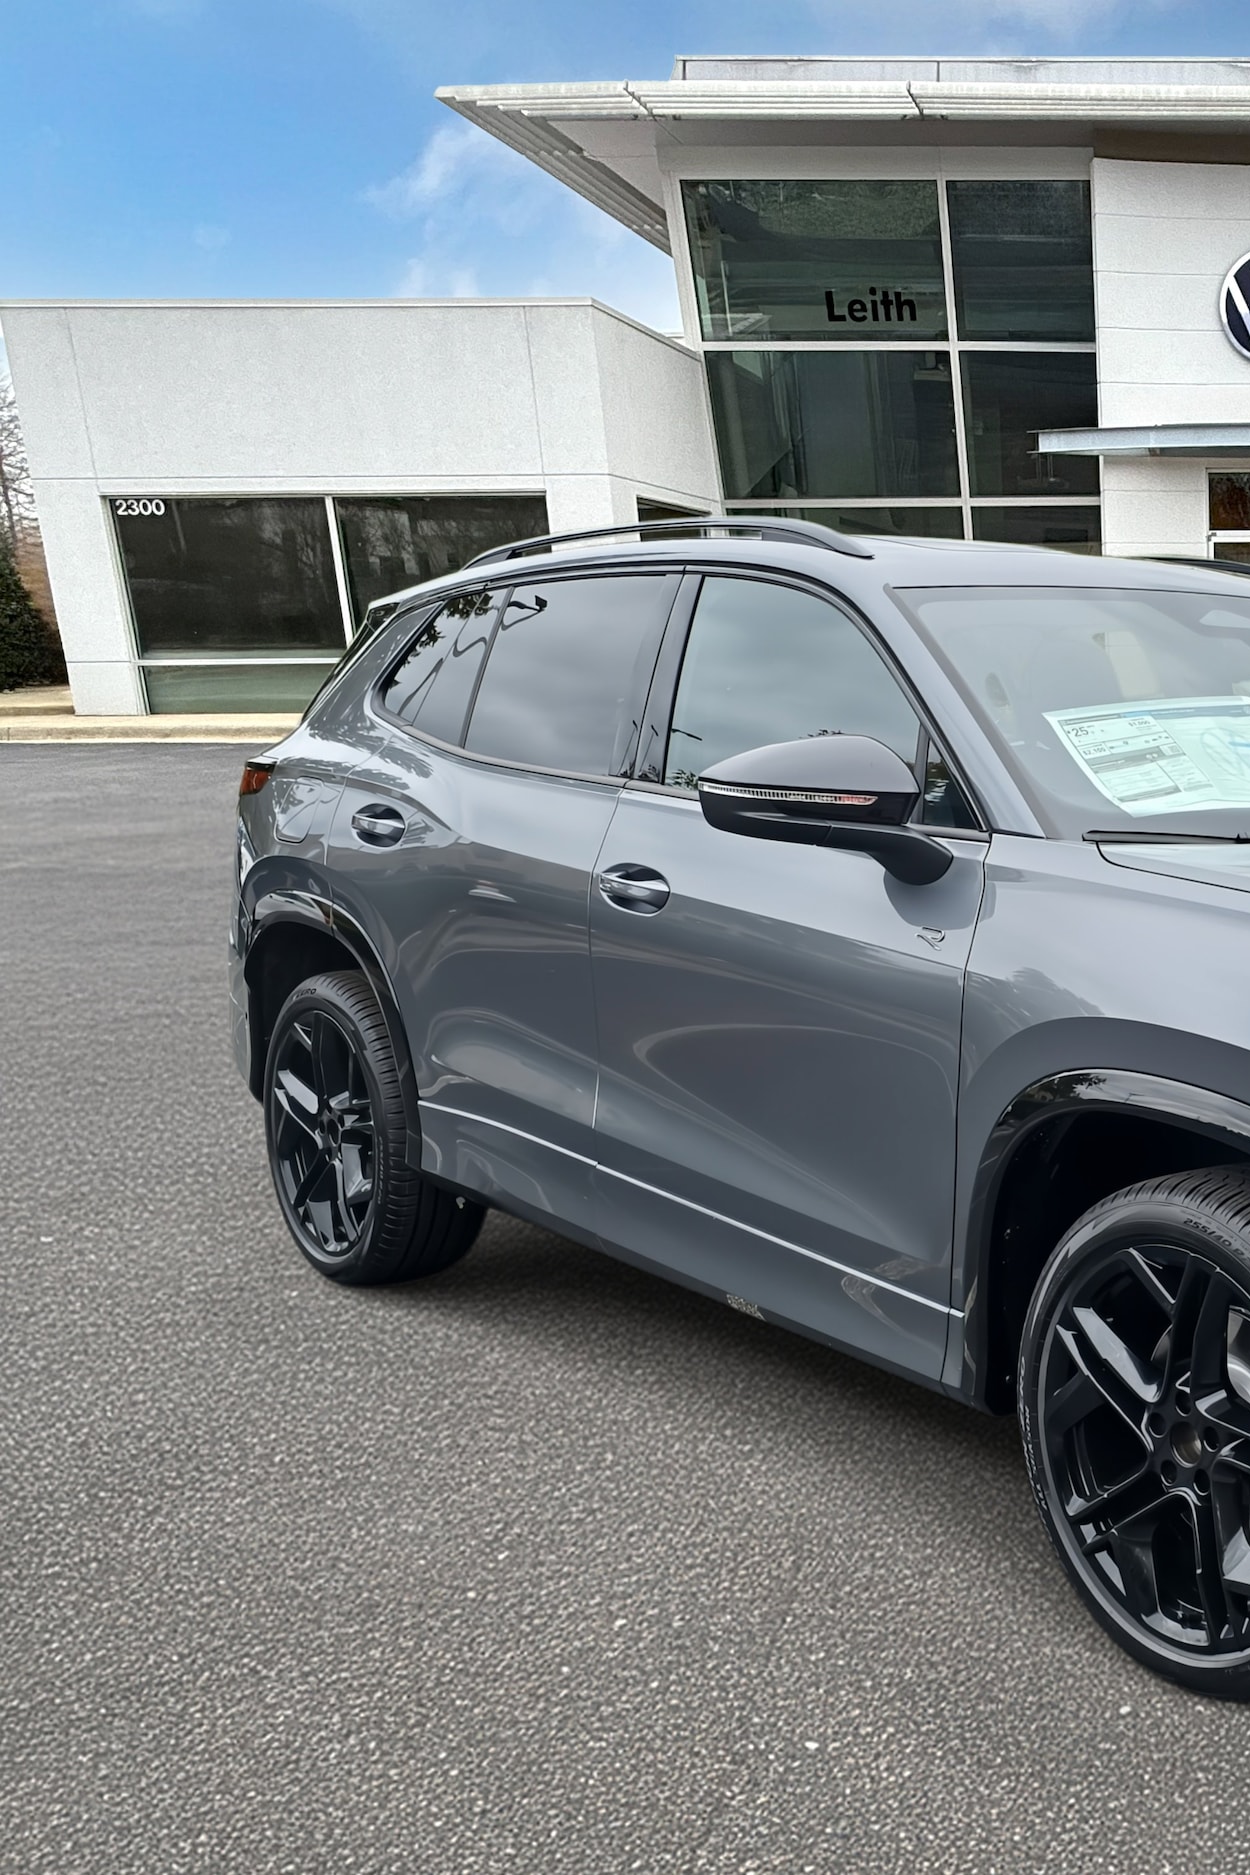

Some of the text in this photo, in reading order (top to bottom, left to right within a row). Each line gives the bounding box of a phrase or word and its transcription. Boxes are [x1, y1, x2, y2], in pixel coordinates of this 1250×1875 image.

[824, 286, 917, 323] Leith
[115, 499, 166, 516] 2300
[1071, 726, 1089, 738] 25
